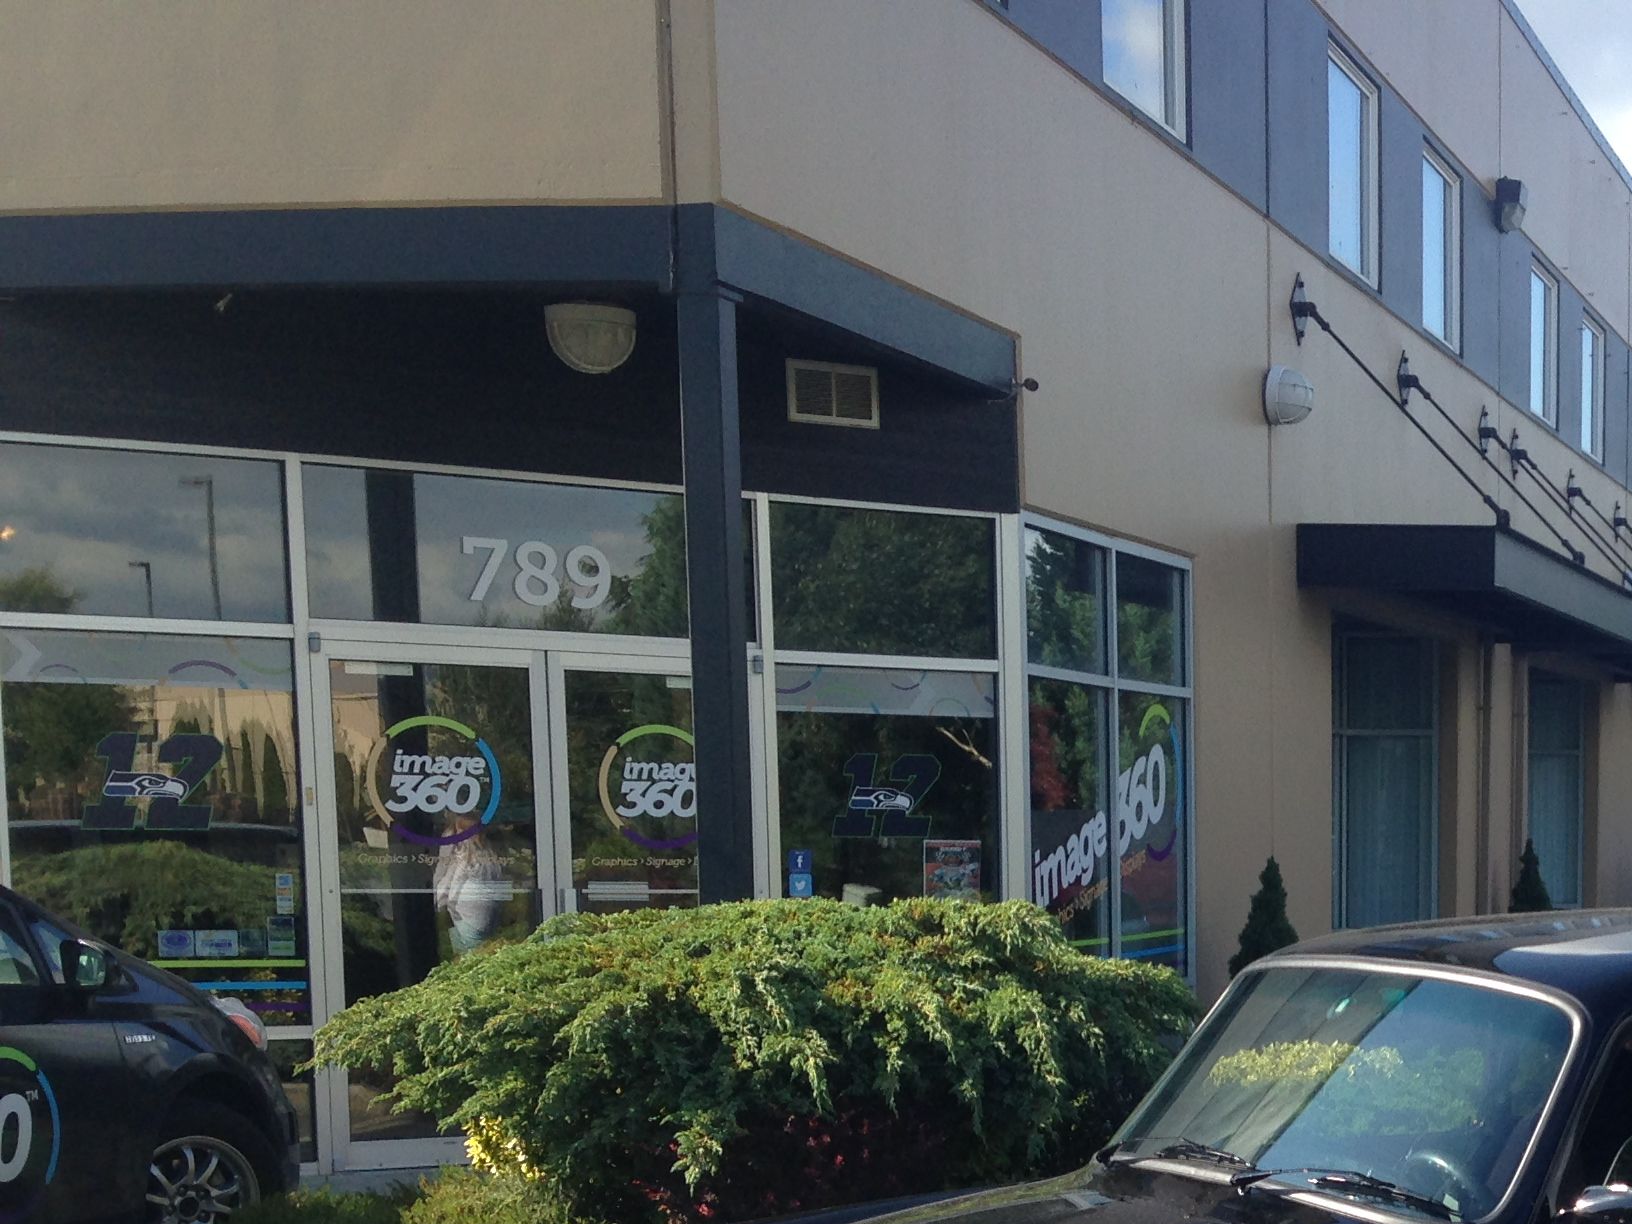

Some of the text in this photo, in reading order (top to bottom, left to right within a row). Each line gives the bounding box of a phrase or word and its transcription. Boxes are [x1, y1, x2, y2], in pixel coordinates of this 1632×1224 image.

[460, 536, 611, 609] 789
[81, 731, 224, 830] 12
[393, 749, 487, 776] image
[623, 756, 696, 782] imag
[385, 774, 481, 814] 360
[615, 780, 697, 818] 360
[832, 753, 942, 838] 12
[591, 857, 638, 867] Graphics
[646, 857, 686, 869] Signage
[1034, 810, 1108, 908] image
